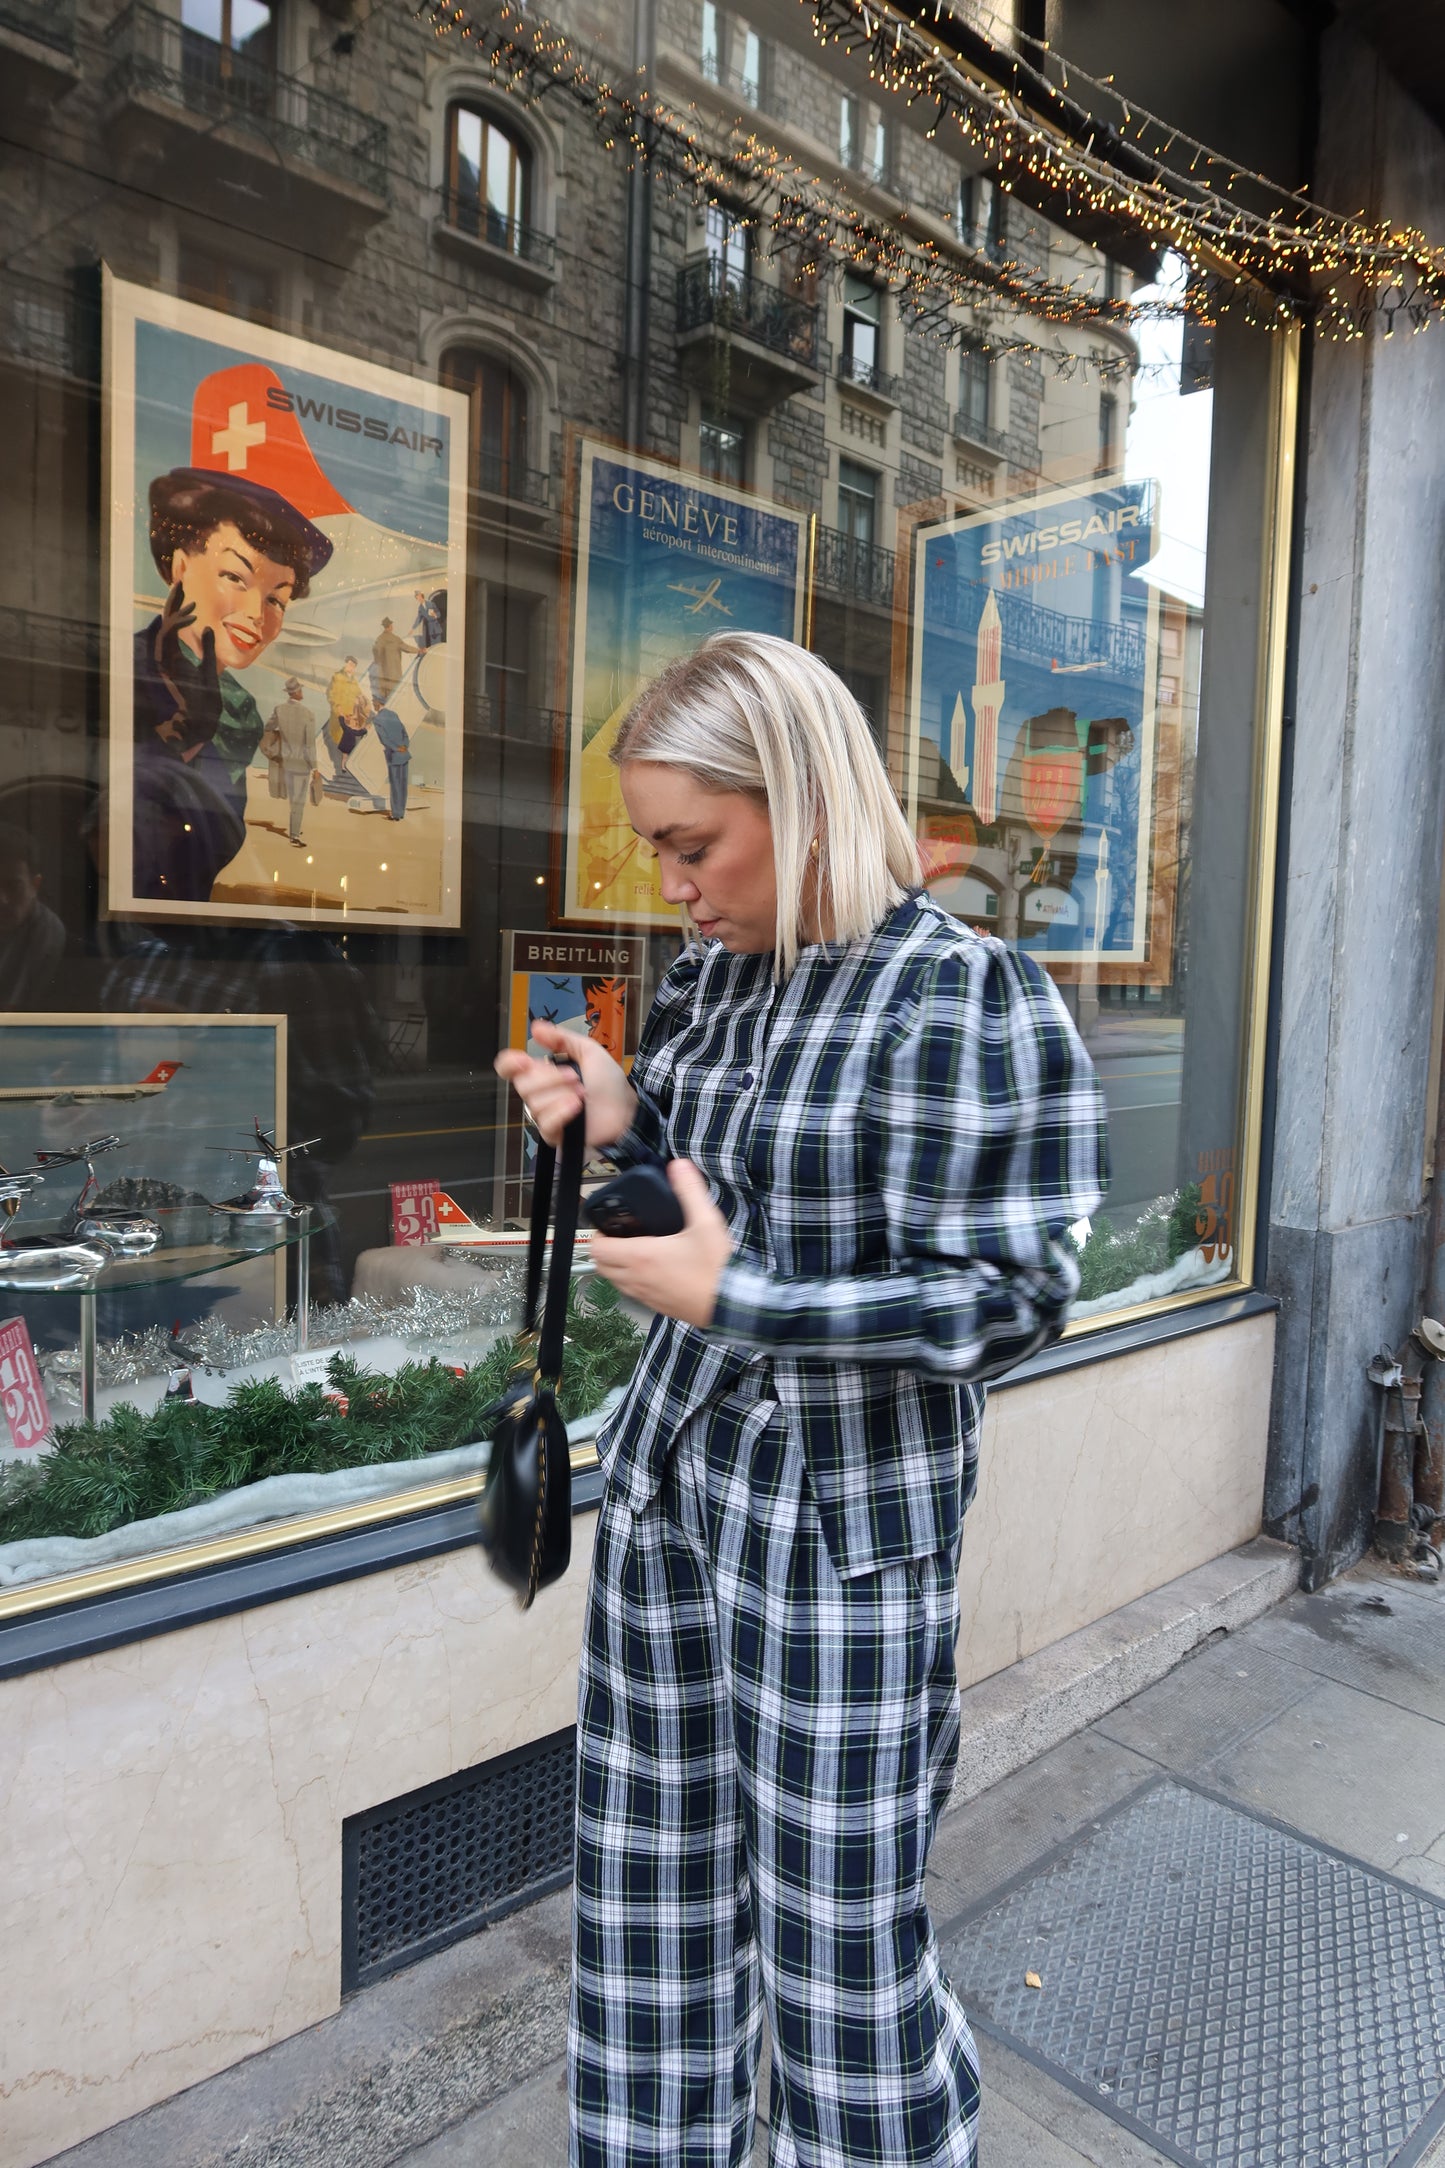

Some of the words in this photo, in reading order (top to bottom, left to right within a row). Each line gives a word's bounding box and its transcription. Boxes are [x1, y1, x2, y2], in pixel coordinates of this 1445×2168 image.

[266, 387, 443, 458] SWISSAIR
[612, 483, 738, 546] GENÈVE
[981, 505, 1139, 566] SWISSAIR
[643, 525, 692, 550] aéroport
[697, 539, 779, 576] intercontinental
[1000, 554, 1077, 589] MIDDLE
[1086, 539, 1140, 572] EAST
[527, 945, 630, 963] BREITLING
[298, 1360, 314, 1368] LISTE
